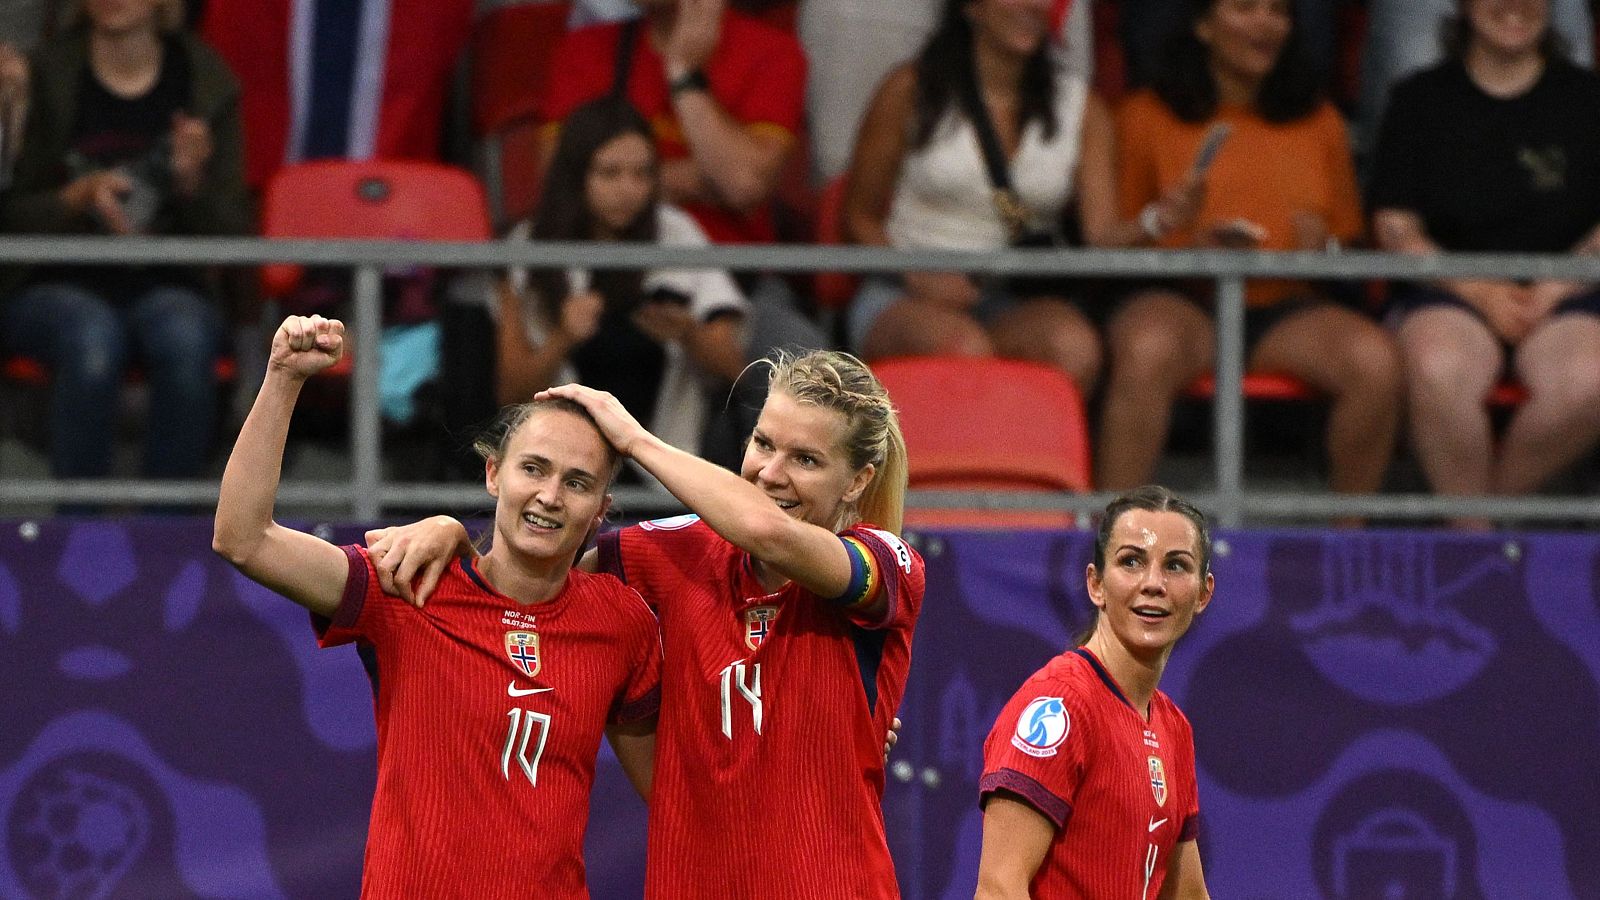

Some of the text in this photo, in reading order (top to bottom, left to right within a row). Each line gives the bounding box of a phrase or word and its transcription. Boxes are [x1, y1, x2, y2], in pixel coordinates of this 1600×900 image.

[505, 610, 520, 618] NOR
[719, 658, 763, 740] 14
[501, 707, 551, 788] 10
